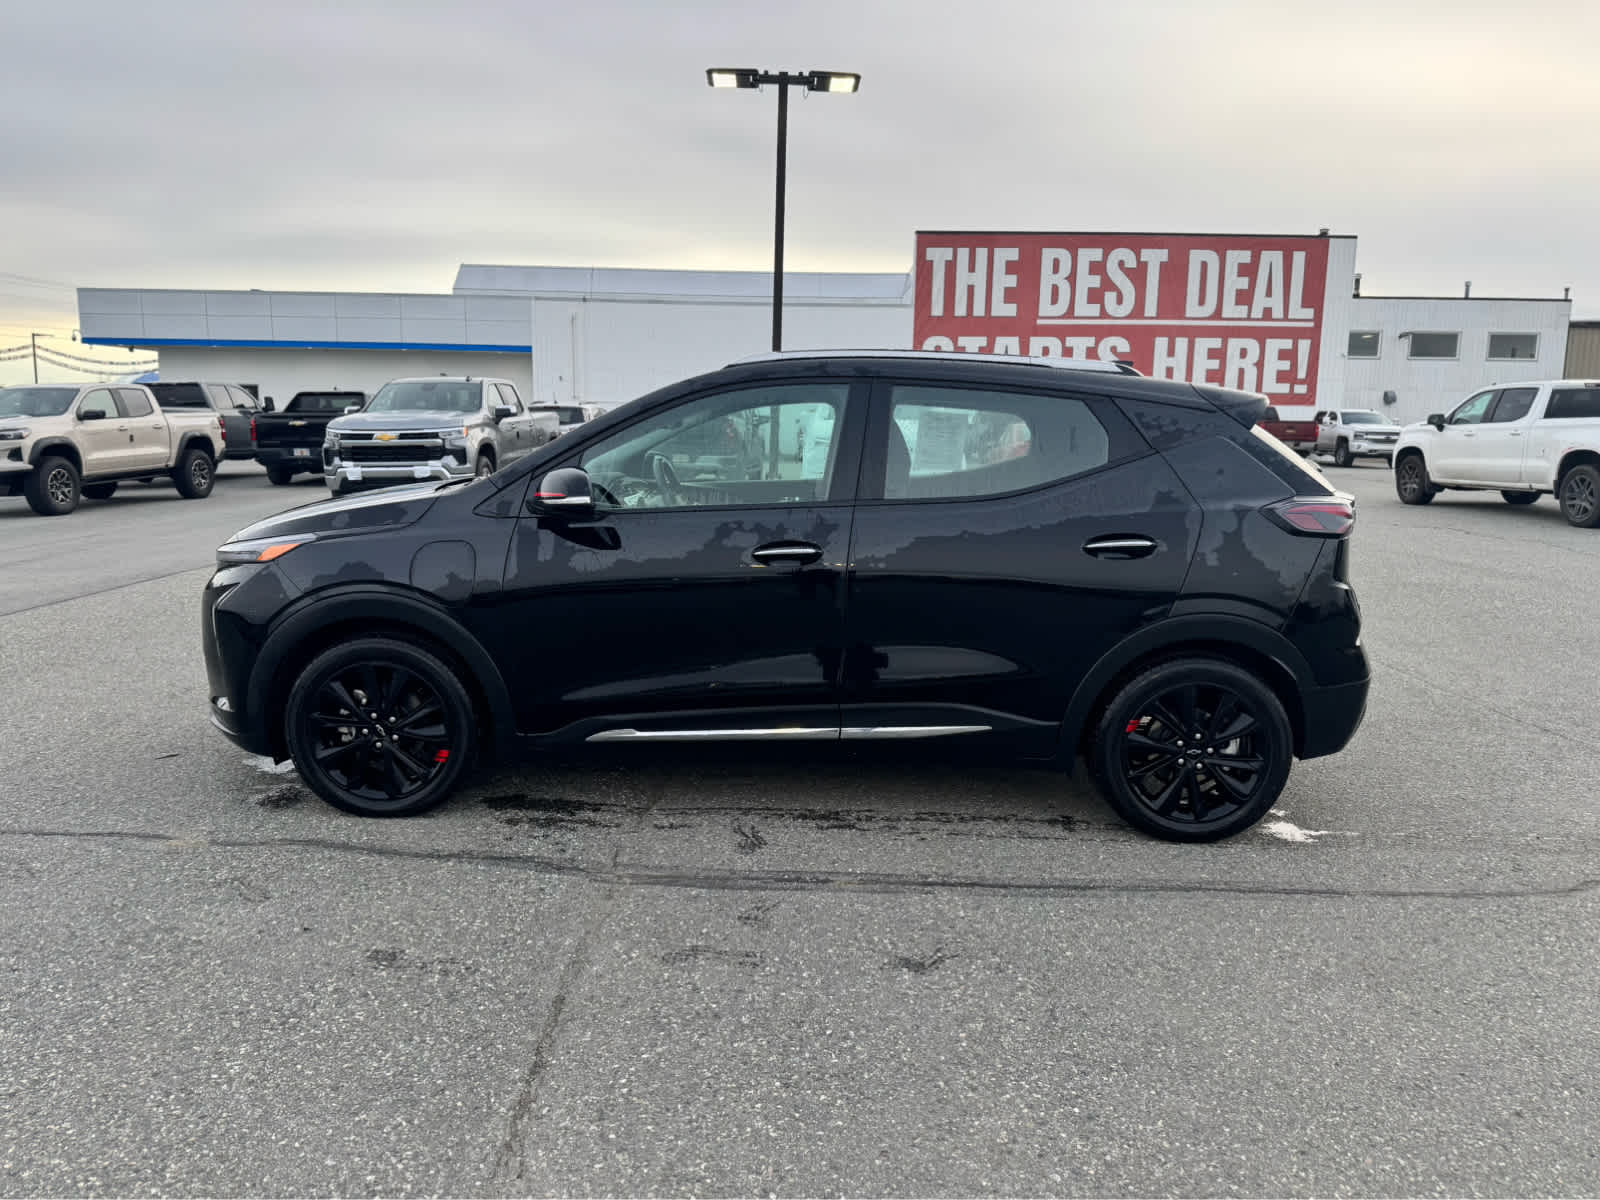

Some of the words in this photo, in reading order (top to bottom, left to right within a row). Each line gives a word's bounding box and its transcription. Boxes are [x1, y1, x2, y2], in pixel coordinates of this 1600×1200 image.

[926, 247, 1020, 317] THE
[1038, 247, 1169, 318] BEST
[1185, 249, 1315, 320] DEAL
[1152, 336, 1312, 394] HERE!
